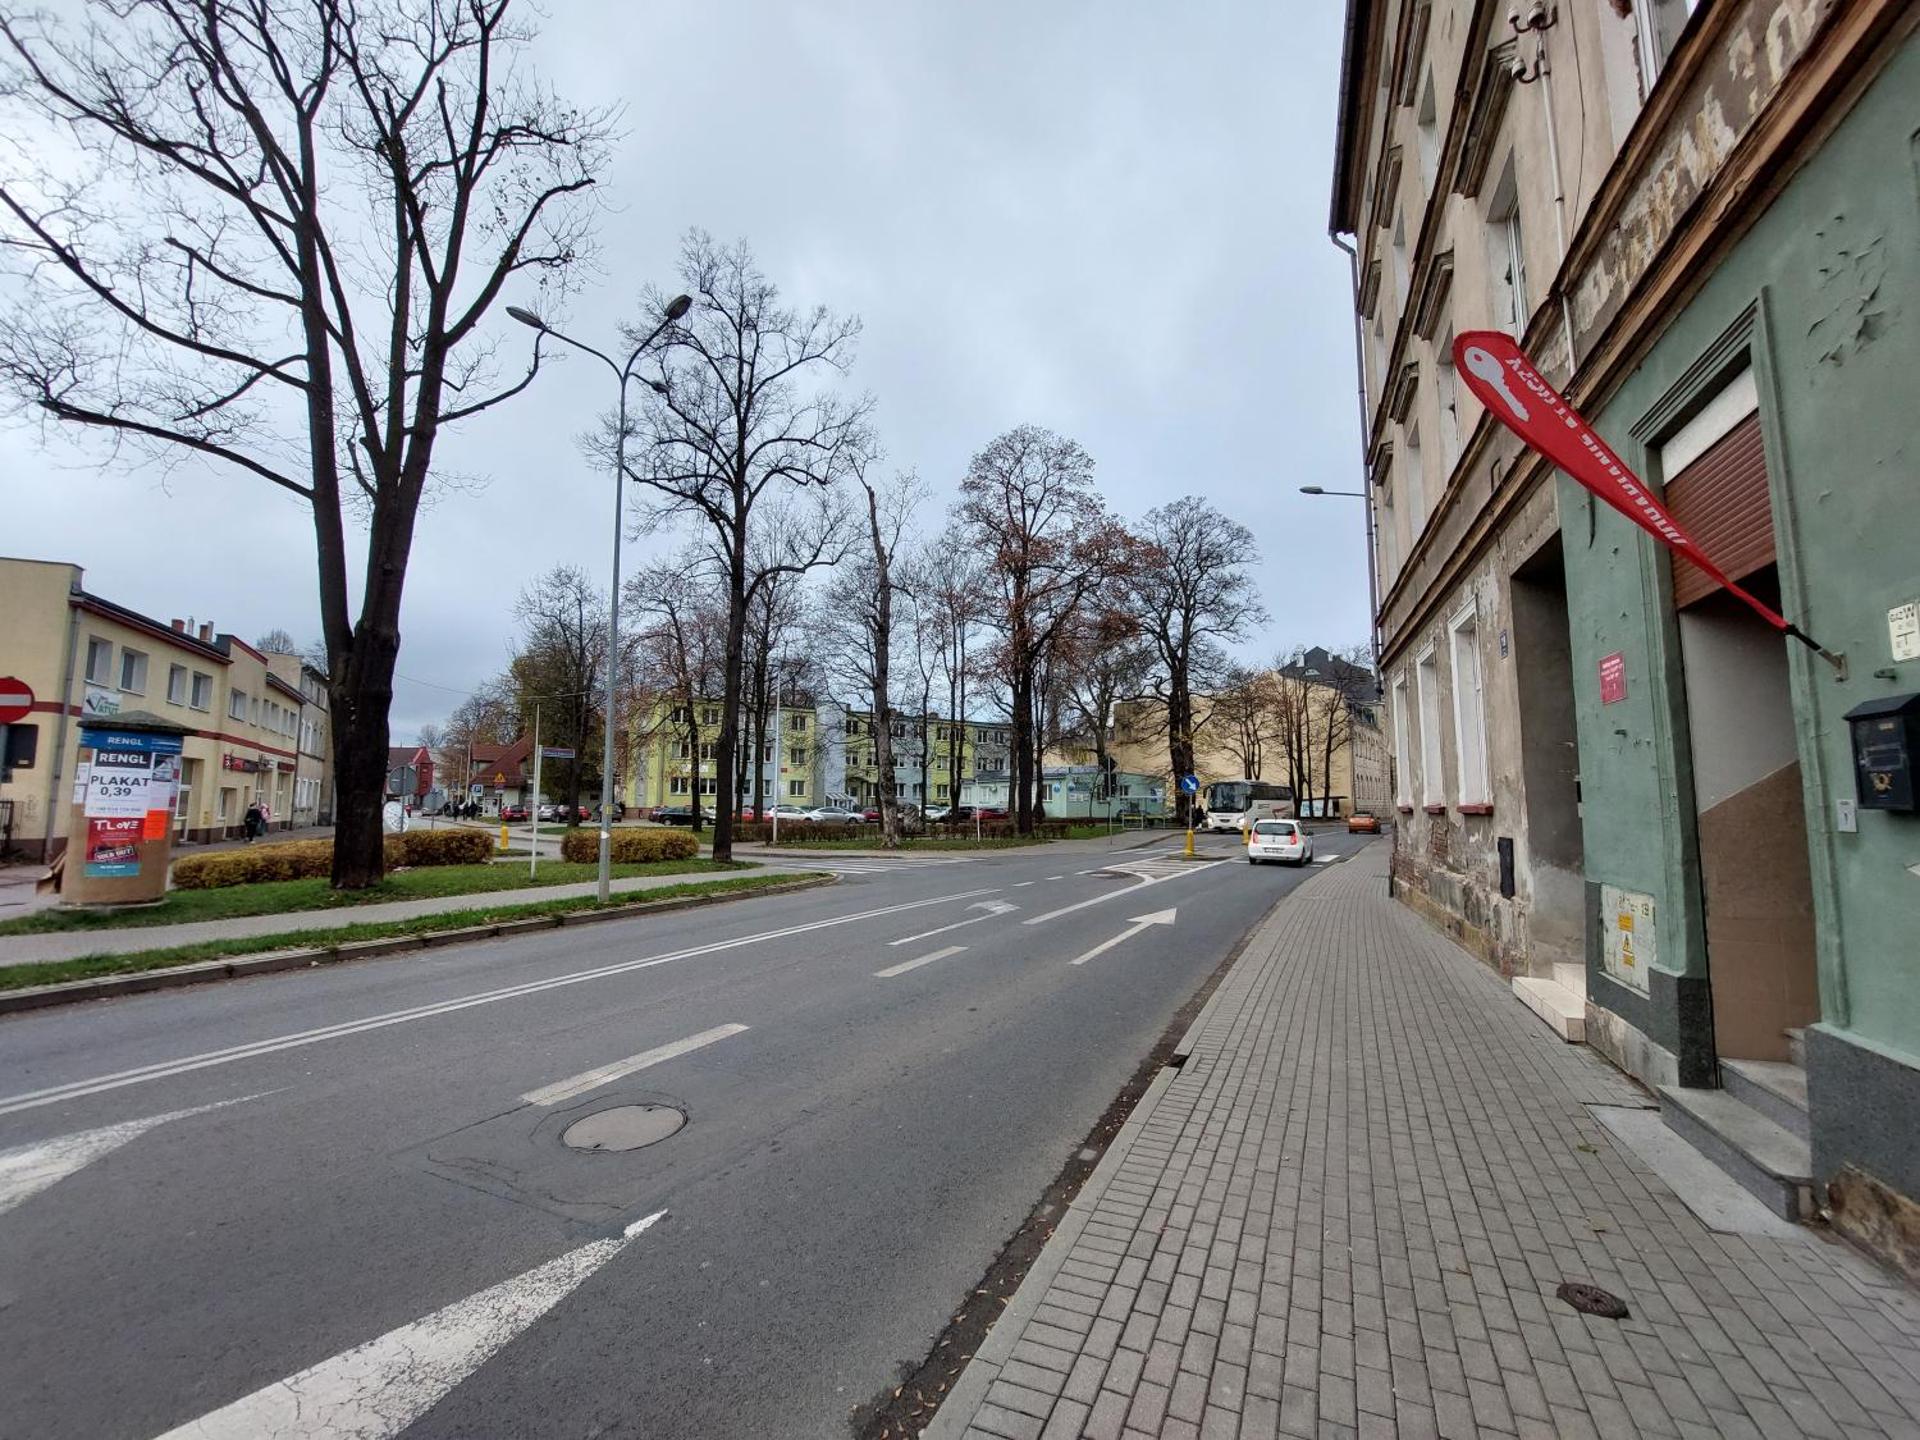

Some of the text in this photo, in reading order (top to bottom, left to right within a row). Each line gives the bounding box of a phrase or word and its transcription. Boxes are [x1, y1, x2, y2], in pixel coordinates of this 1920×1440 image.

[107, 736, 144, 746] RENGL
[99, 753, 147, 765] RENGL
[91, 775, 151, 787] PLAKAT
[100, 786, 132, 798] 0,39
